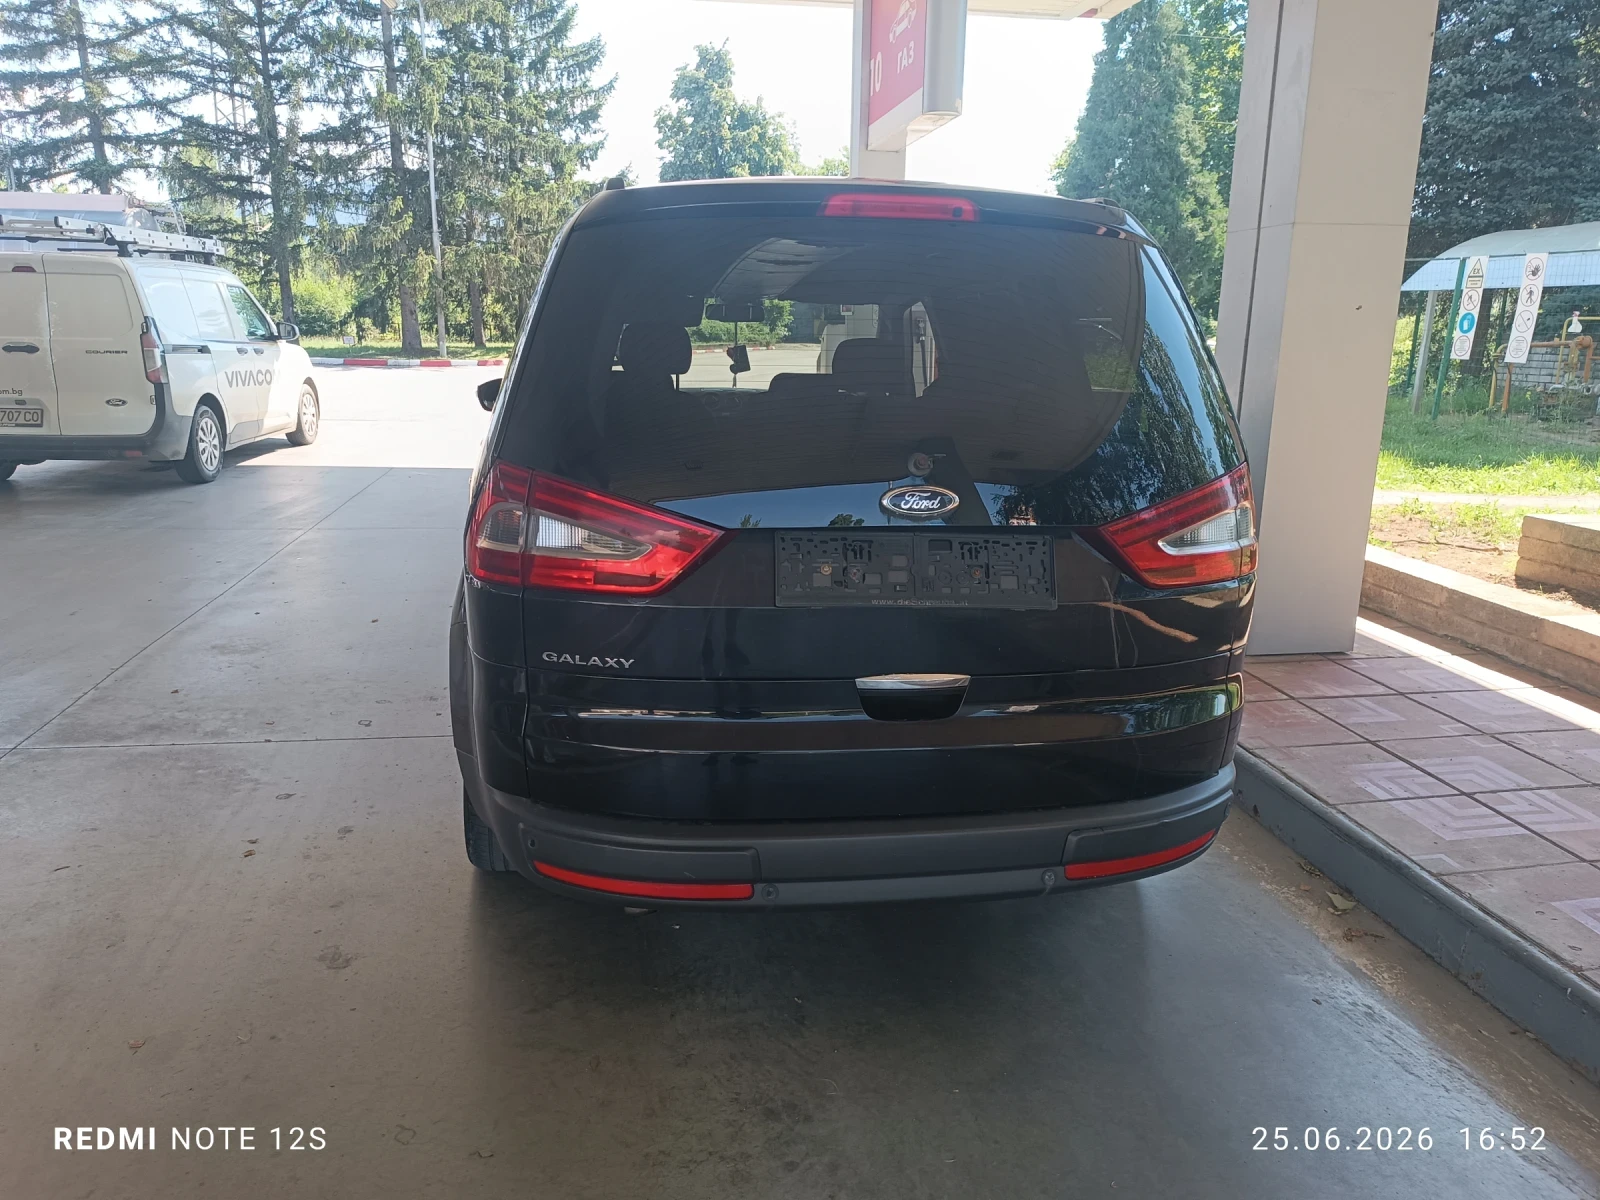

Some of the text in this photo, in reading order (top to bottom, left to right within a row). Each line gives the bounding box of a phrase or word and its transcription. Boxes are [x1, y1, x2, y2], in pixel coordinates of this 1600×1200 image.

[897, 40, 914, 74] ГАЗ
[870, 51, 882, 97] 10
[224, 369, 280, 388] VIVACO
[24, 411, 40, 423] CO
[900, 492, 941, 510] Ford
[541, 651, 635, 669] GALAXY
